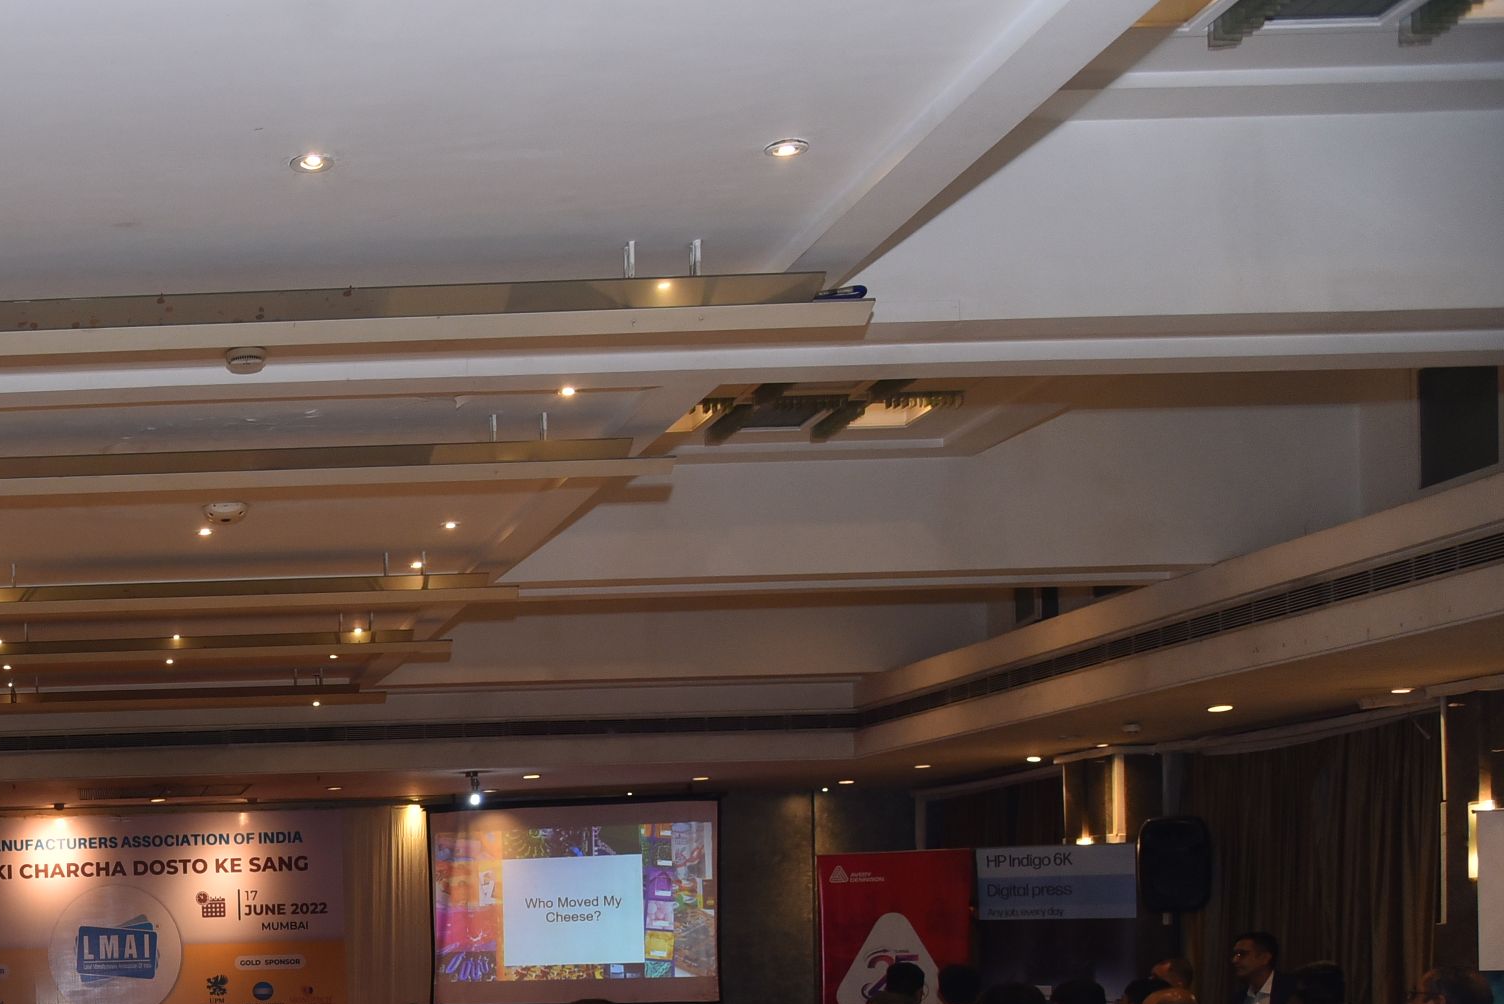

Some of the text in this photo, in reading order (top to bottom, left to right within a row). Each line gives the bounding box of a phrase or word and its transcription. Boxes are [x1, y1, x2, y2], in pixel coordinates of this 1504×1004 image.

[120, 833, 230, 848] ASSOCIATION
[233, 832, 255, 845] OF
[258, 831, 303, 844] INDIA
[19, 861, 127, 879] CHARCHA
[133, 858, 208, 876] DOSTO
[215, 858, 243, 873] KE
[248, 856, 309, 872] SANG
[986, 852, 1072, 870] HP Indigo 6K
[244, 890, 258, 901] 17
[987, 883, 1072, 900] Digital press
[244, 902, 328, 916] JUNE 2022
[525, 896, 622, 909] Who Moved My
[546, 910, 602, 922] Cheese?
[261, 921, 309, 931] MUMBAI
[83, 933, 151, 960] LMAI
[264, 958, 300, 966] SPONSOR
